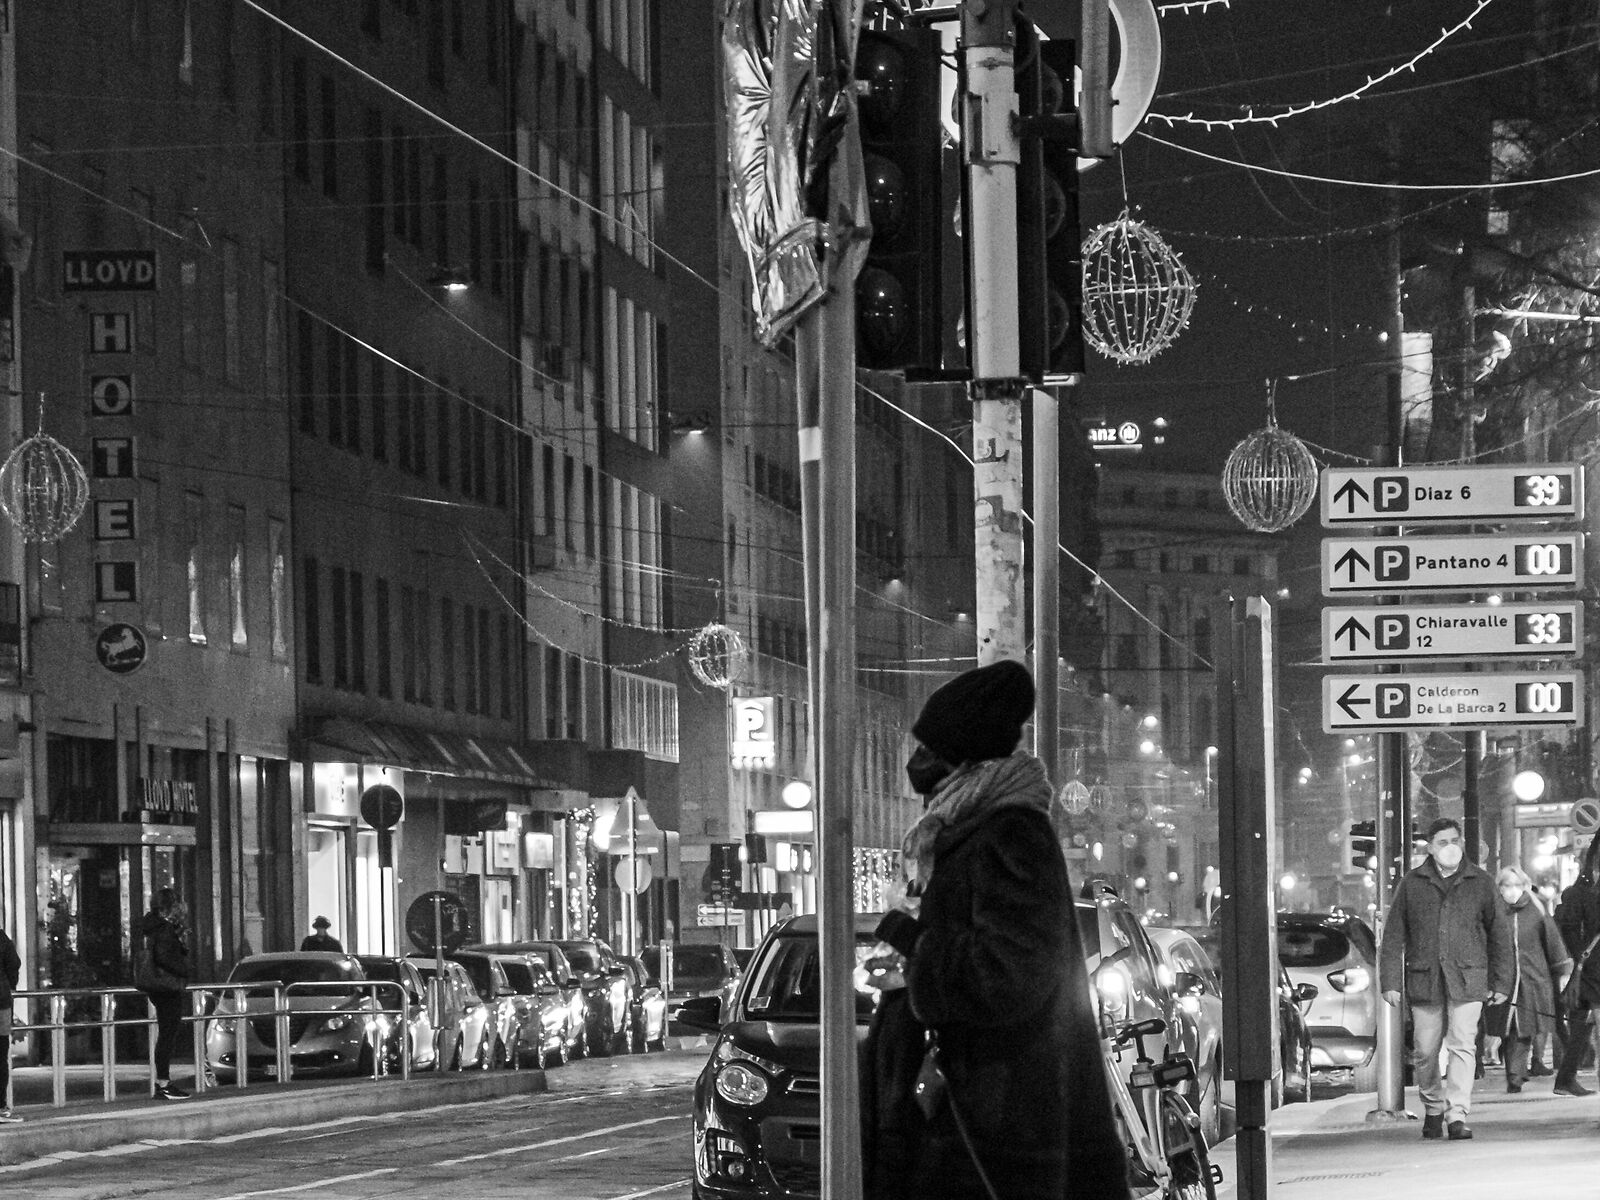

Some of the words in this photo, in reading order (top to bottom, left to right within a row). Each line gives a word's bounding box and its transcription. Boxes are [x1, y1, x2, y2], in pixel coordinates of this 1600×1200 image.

[65, 260, 153, 285] LLOYD
[92, 314, 131, 600] HOTEL
[1382, 481, 1402, 508] P
[1415, 486, 1452, 501] Diaz
[1460, 486, 1471, 500] 6
[1526, 475, 1560, 506] 39
[1383, 550, 1403, 577] P
[1416, 555, 1490, 569] Pantano
[1496, 554, 1508, 567] 4
[1527, 545, 1560, 574] 00
[1383, 619, 1403, 646] P
[1416, 616, 1508, 629] Chiaravalle
[1527, 613, 1560, 644] 33
[1417, 635, 1432, 648] 12
[1384, 688, 1404, 714] P
[1417, 686, 1479, 698] Calderon
[1528, 682, 1561, 713] 00
[1417, 704, 1434, 714] De
[1438, 703, 1454, 714] La
[1457, 703, 1494, 714] Barca
[1498, 702, 1507, 713] 2
